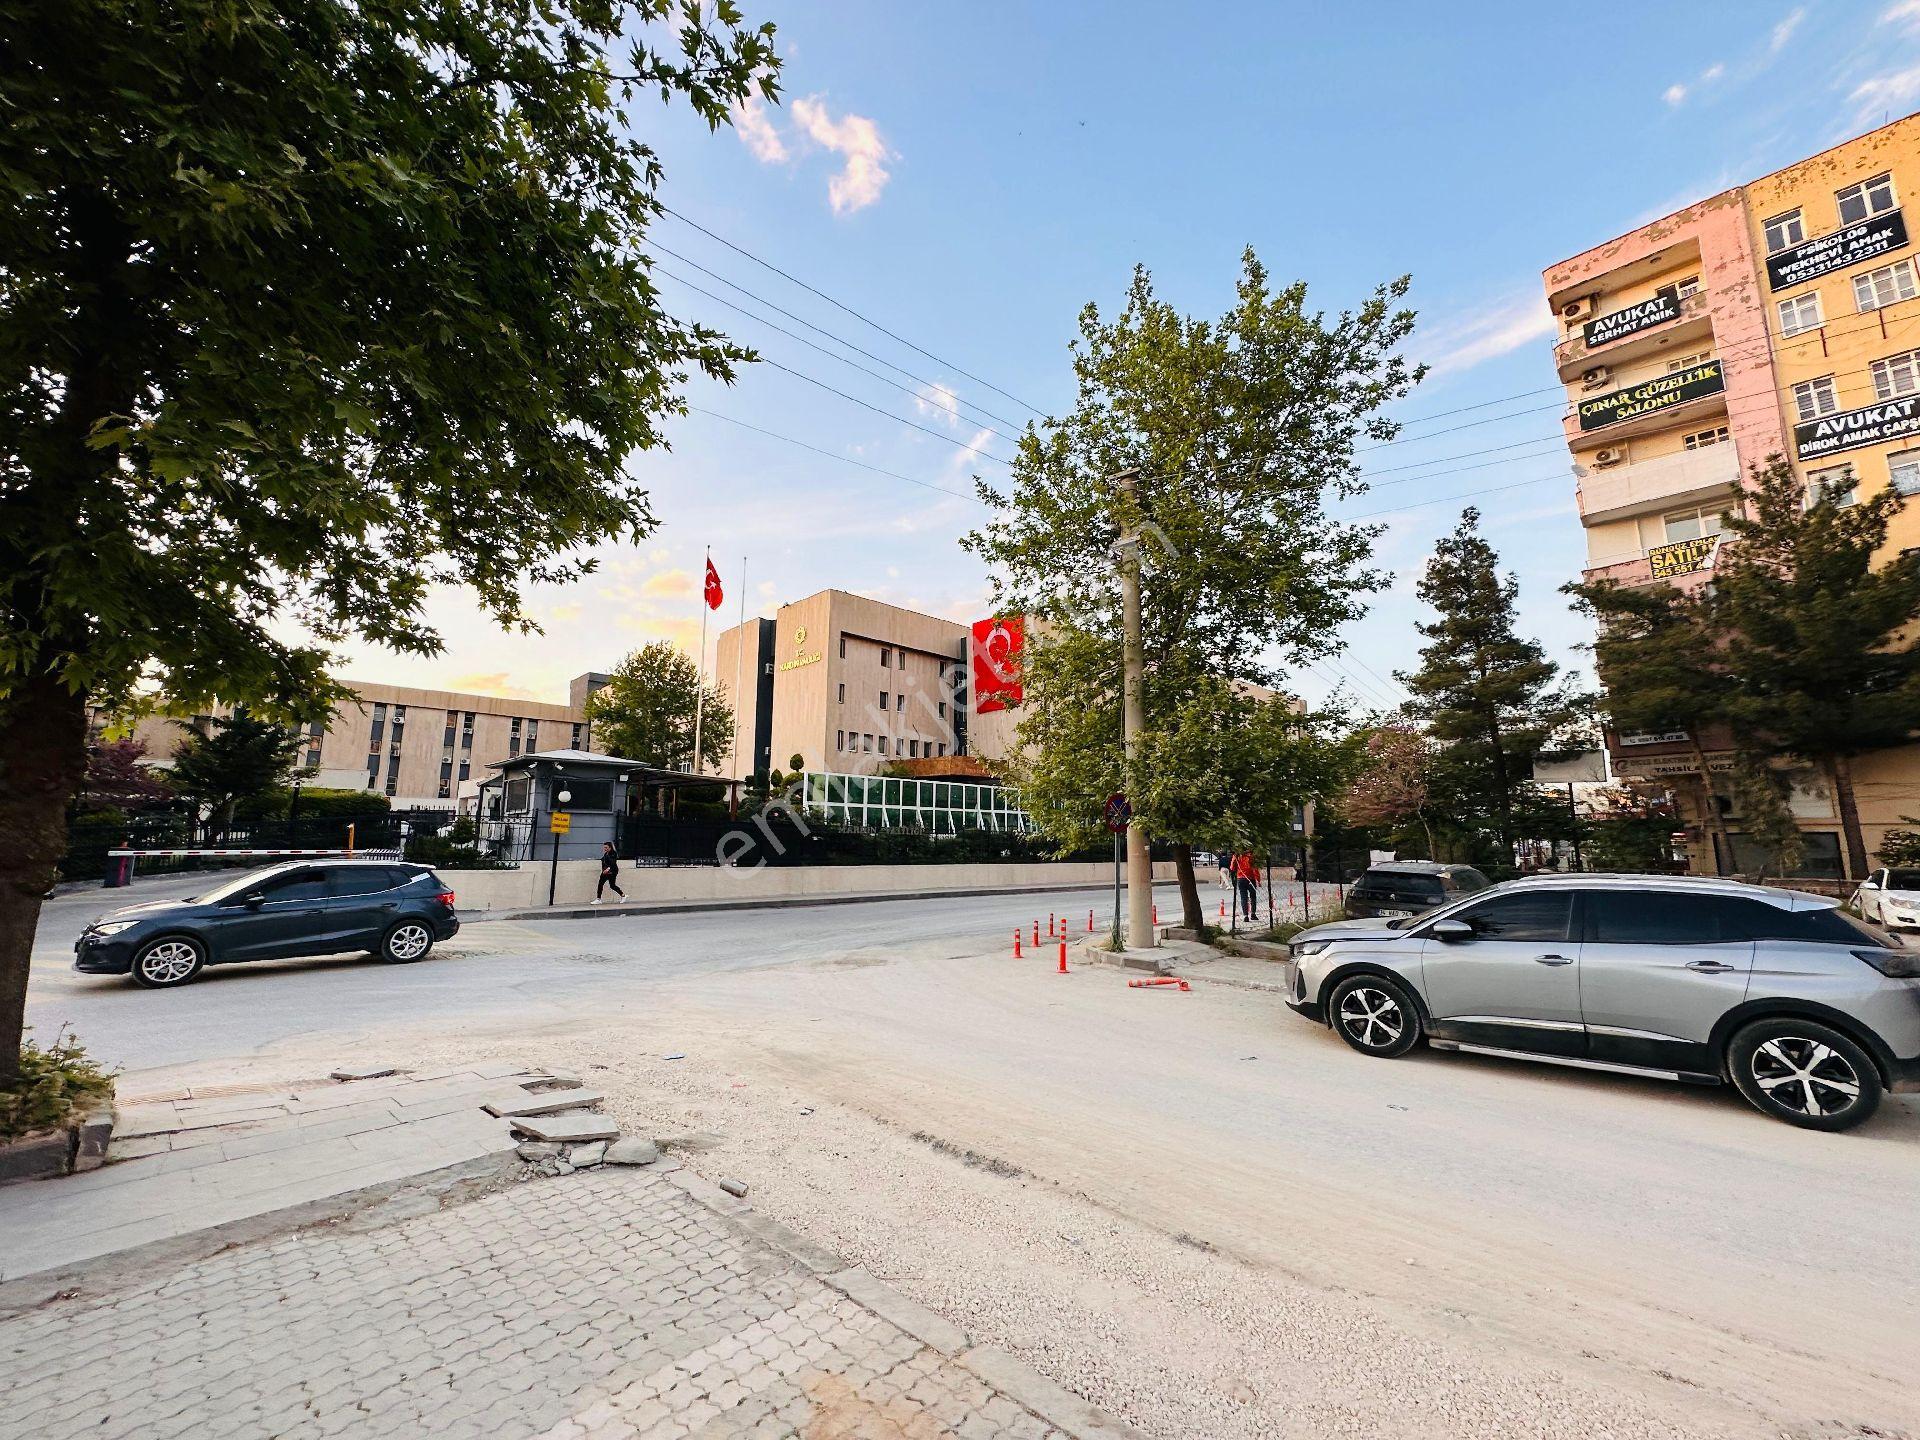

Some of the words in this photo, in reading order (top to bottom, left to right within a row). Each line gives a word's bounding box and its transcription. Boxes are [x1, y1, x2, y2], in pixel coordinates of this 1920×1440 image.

[1778, 245, 1843, 275] WEKHEVİ
[1848, 227, 1894, 251] AMAK
[1796, 226, 1868, 258] PSİKOLOG
[1589, 320, 1639, 345] SERHAT
[1640, 307, 1675, 326] ANIK
[1594, 296, 1668, 333] AVUKAT
[1581, 392, 1636, 417] ÇINAR
[1635, 365, 1719, 399] GÜZELLİK
[1616, 390, 1681, 420] SALONU
[1800, 435, 1840, 454] DİROK
[1842, 426, 1881, 444] AMAK
[1883, 416, 1920, 437] ÇAPS
[1815, 399, 1916, 438] AVUKAT
[1655, 764, 1701, 774] TAHSİLA
